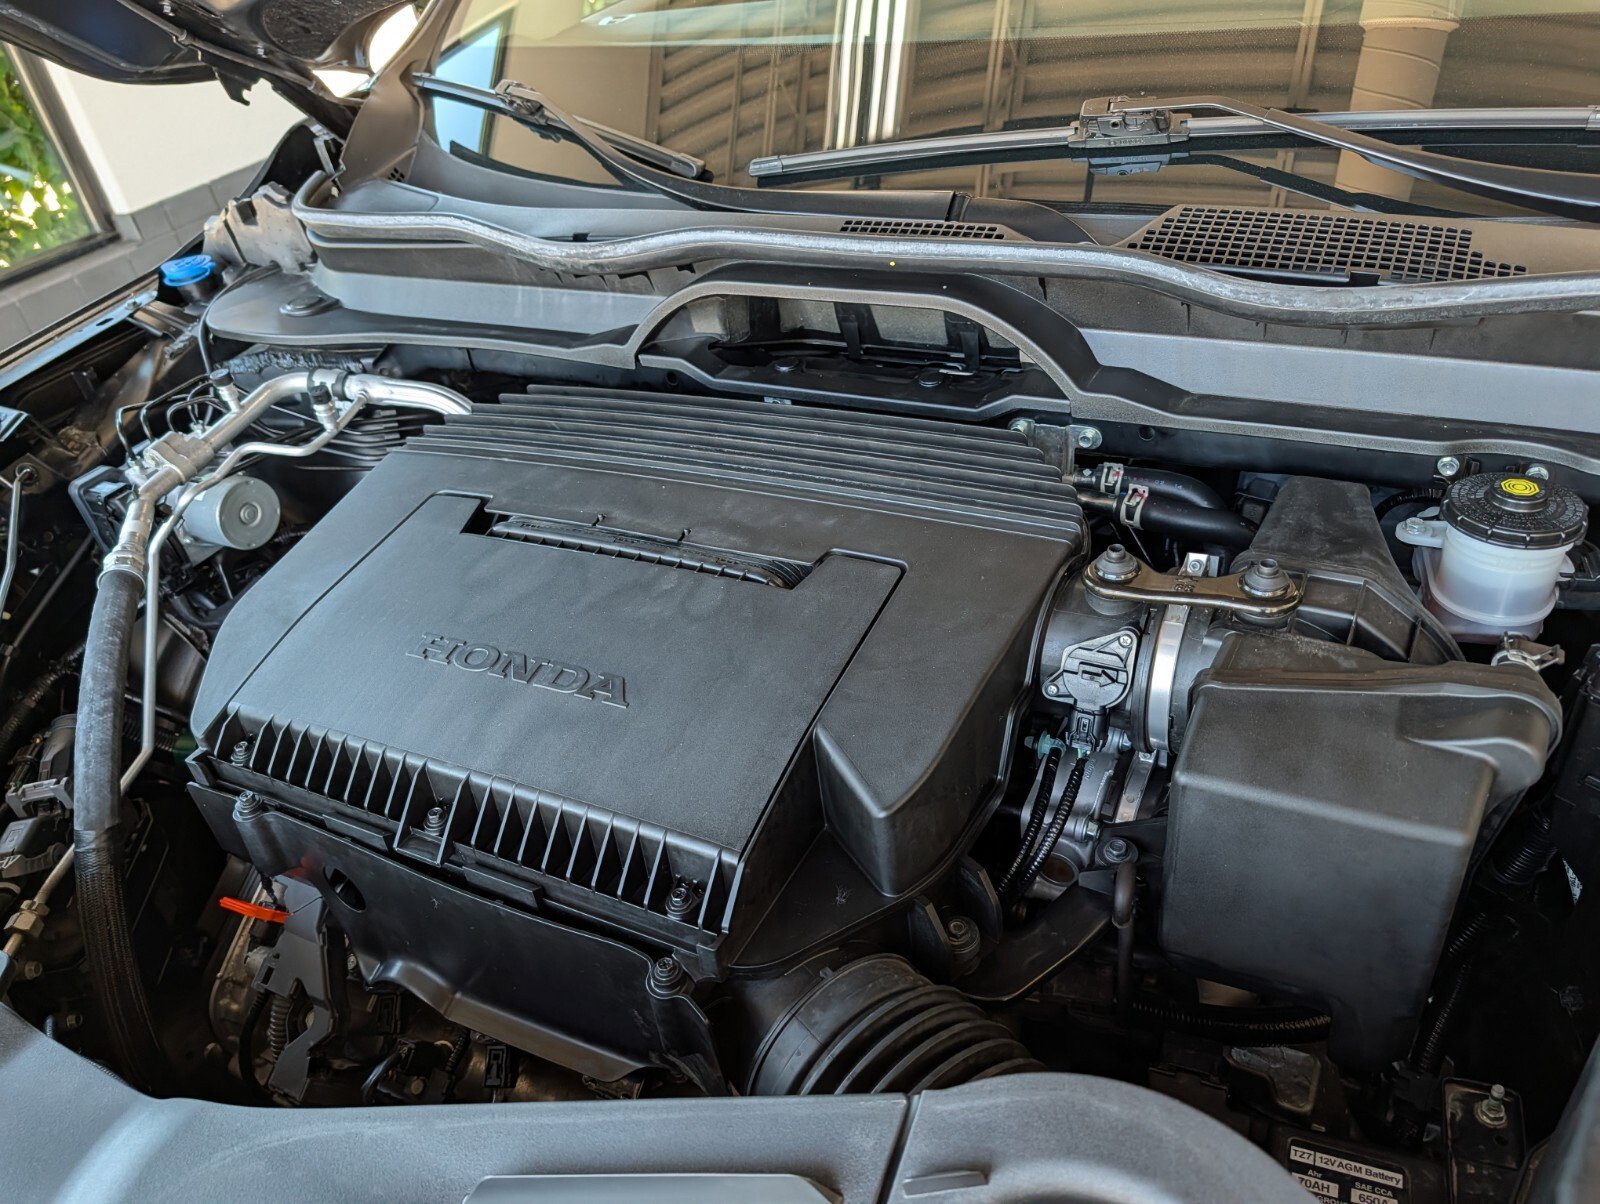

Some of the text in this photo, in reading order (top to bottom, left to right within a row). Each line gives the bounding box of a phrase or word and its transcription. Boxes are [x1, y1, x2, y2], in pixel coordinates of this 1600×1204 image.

[406, 632, 629, 709] HONDA
[1293, 1149, 1312, 1160] TZ7
[1365, 1168, 1400, 1186] Battery
[1355, 1181, 1394, 1198] SAE CCA
